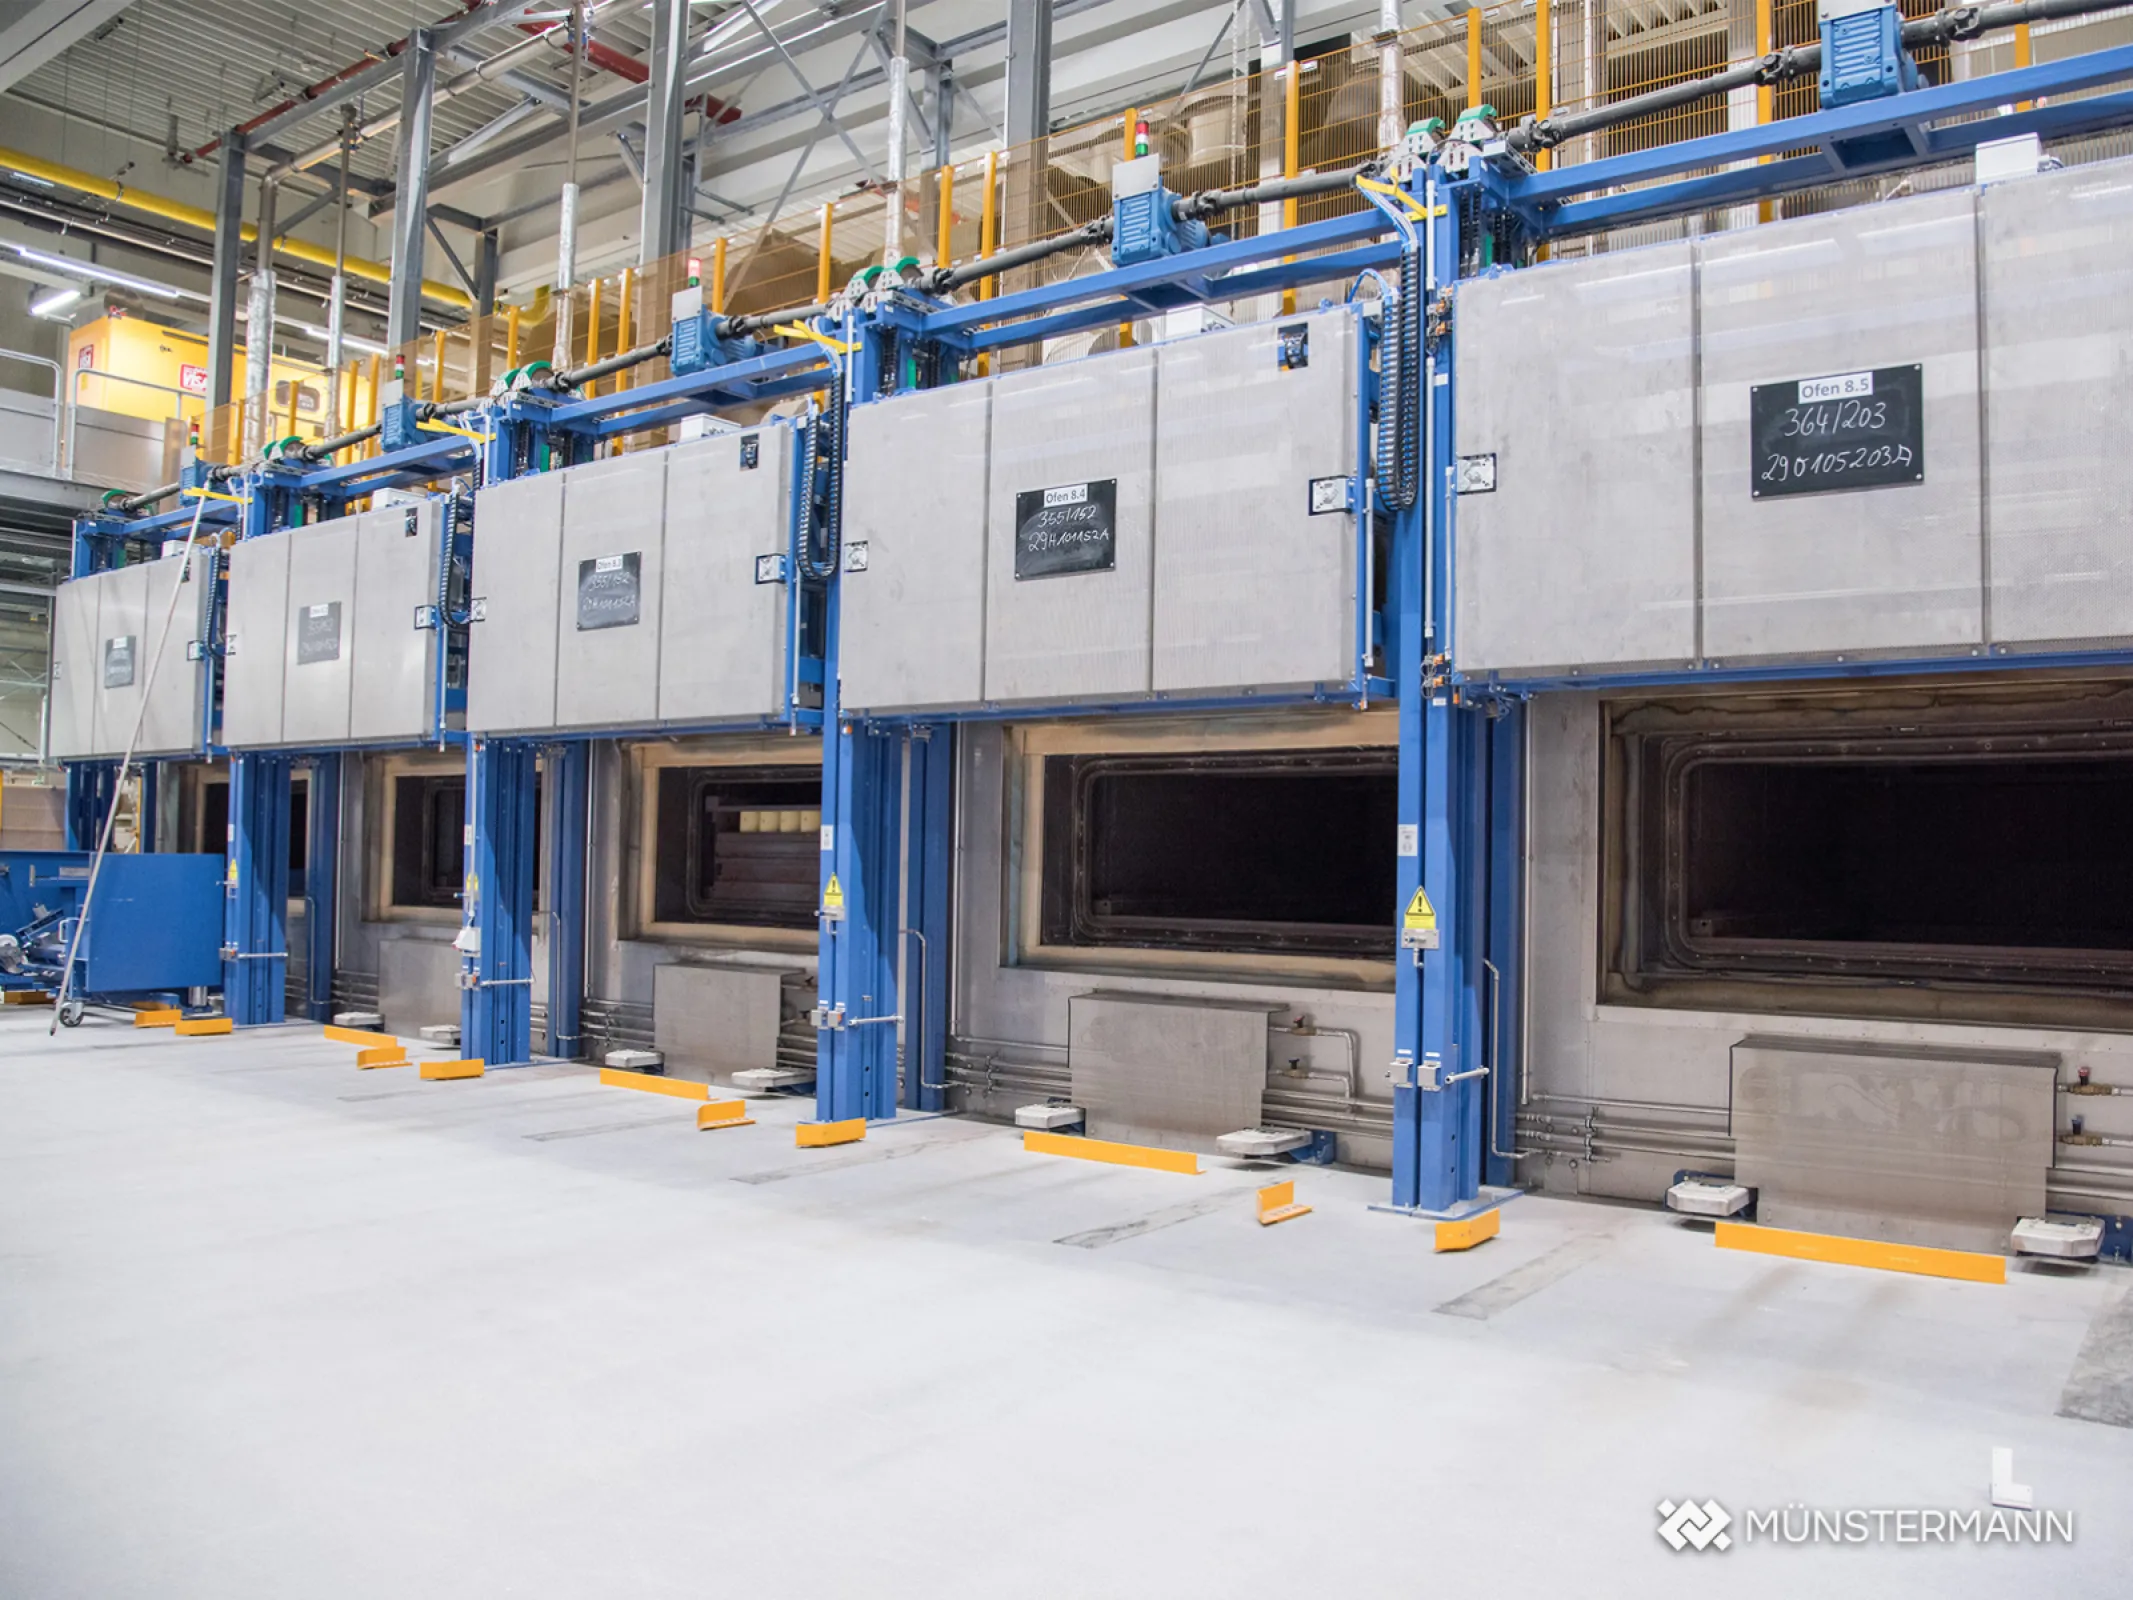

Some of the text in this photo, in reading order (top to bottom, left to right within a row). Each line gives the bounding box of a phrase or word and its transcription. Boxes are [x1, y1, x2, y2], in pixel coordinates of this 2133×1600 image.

[1801, 378, 1870, 399] Ofen 8.5
[1046, 488, 1086, 504] Ofen 8.4
